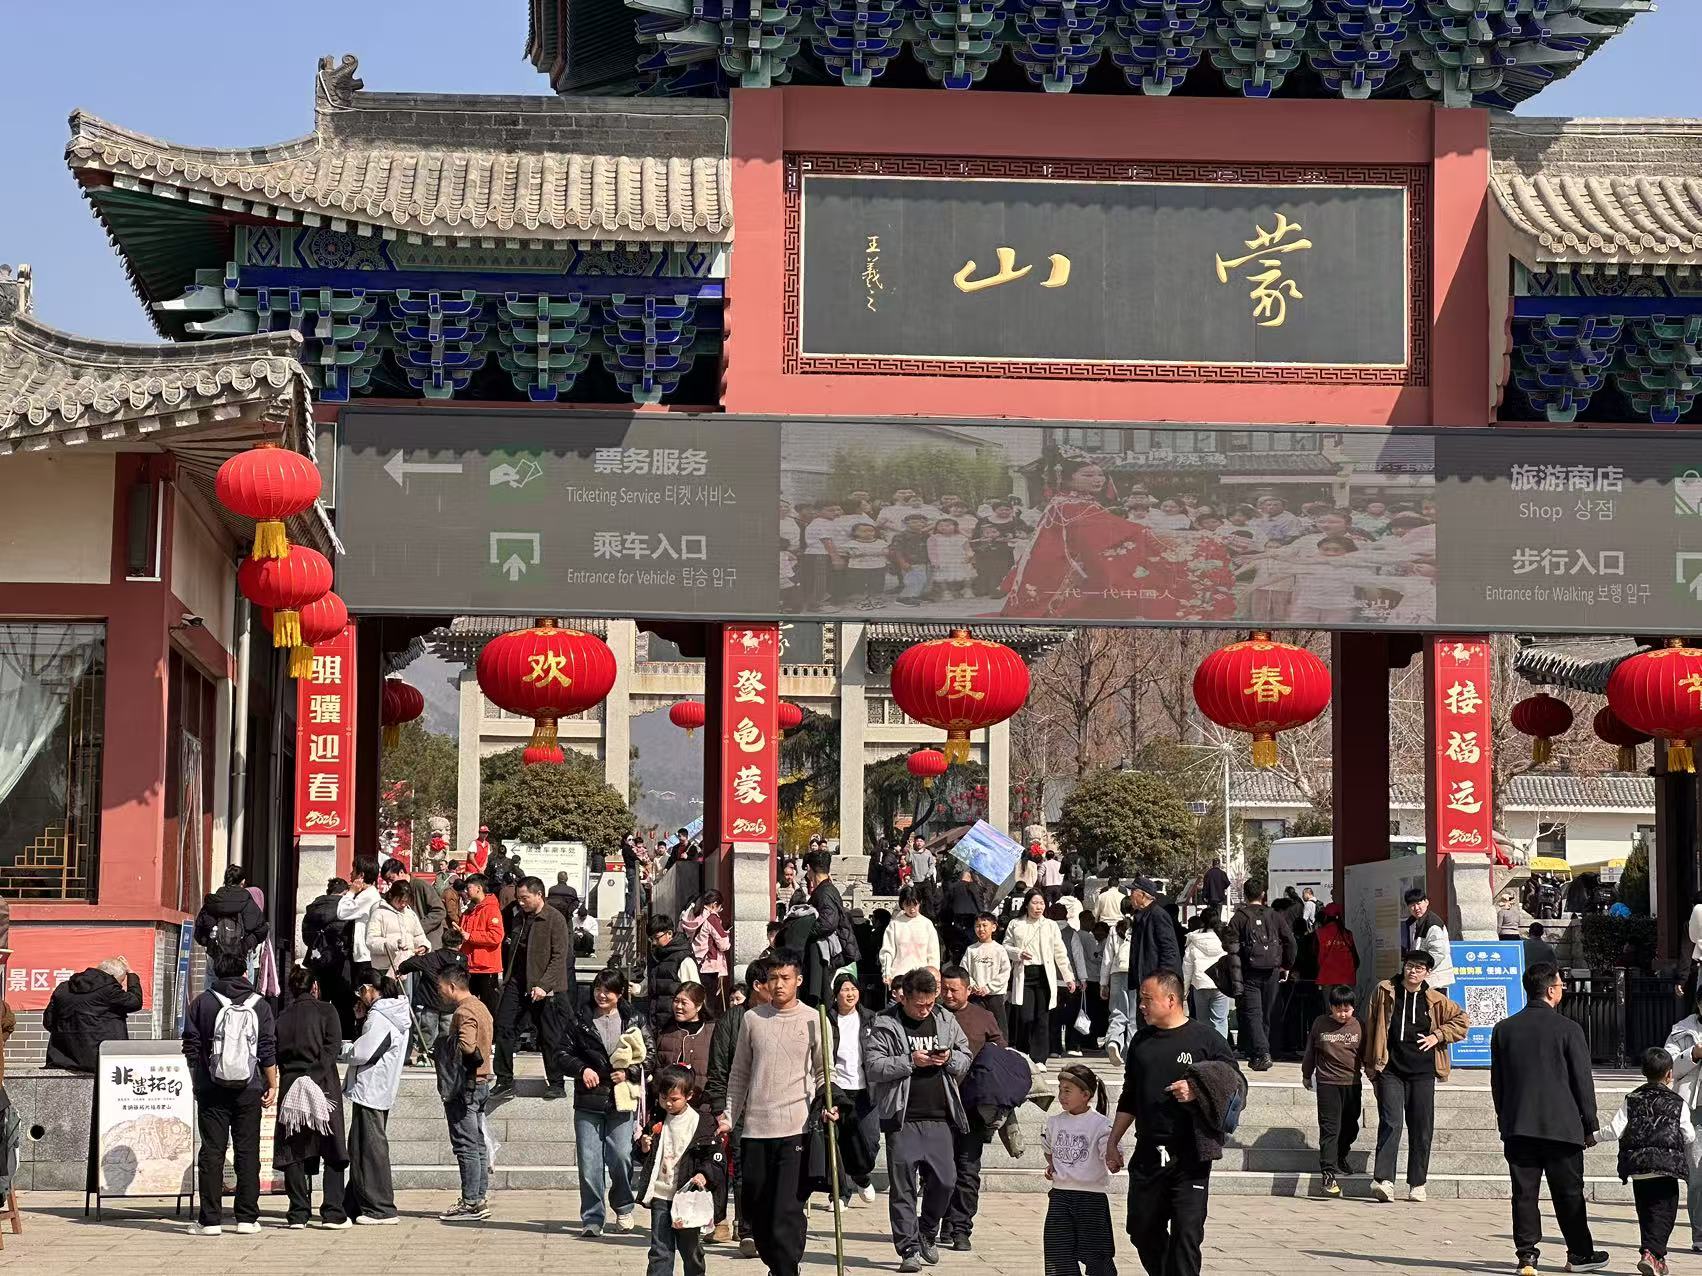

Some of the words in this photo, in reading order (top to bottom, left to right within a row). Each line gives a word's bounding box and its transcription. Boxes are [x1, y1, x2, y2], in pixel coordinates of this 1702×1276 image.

[862, 235, 883, 312] 王羲之
[594, 447, 708, 475] 票务服务
[1510, 464, 1624, 492] 旅游商店
[566, 486, 617, 506] Ticketing
[620, 487, 661, 504] Service
[665, 485, 691, 506] 티켓
[696, 484, 736, 507] 서비스
[1519, 502, 1563, 521] Shop
[1574, 499, 1614, 520] 상점
[593, 531, 707, 560] 乘车入口
[1511, 548, 1625, 575] 步行入口
[567, 568, 616, 584] Entrance
[618, 568, 634, 584] for
[637, 569, 676, 585] Vehicle
[682, 567, 708, 588] 탑승
[713, 567, 737, 588] 입구
[1486, 585, 1532, 601] Entrance
[1534, 585, 1550, 601] for
[1552, 585, 1594, 605] Walking
[1598, 583, 1622, 604] 보행
[1626, 583, 1651, 604] 입구
[522, 650, 572, 688] 欢
[936, 663, 985, 701] 度
[1244, 665, 1293, 703] 春
[309, 655, 342, 802] 骐骥迎春
[1444, 680, 1483, 814] 接福运
[305, 810, 341, 828] 2026
[732, 818, 767, 836] 2026
[1448, 829, 1482, 846] 2026
[111, 1066, 183, 1097] 非遗拓印
